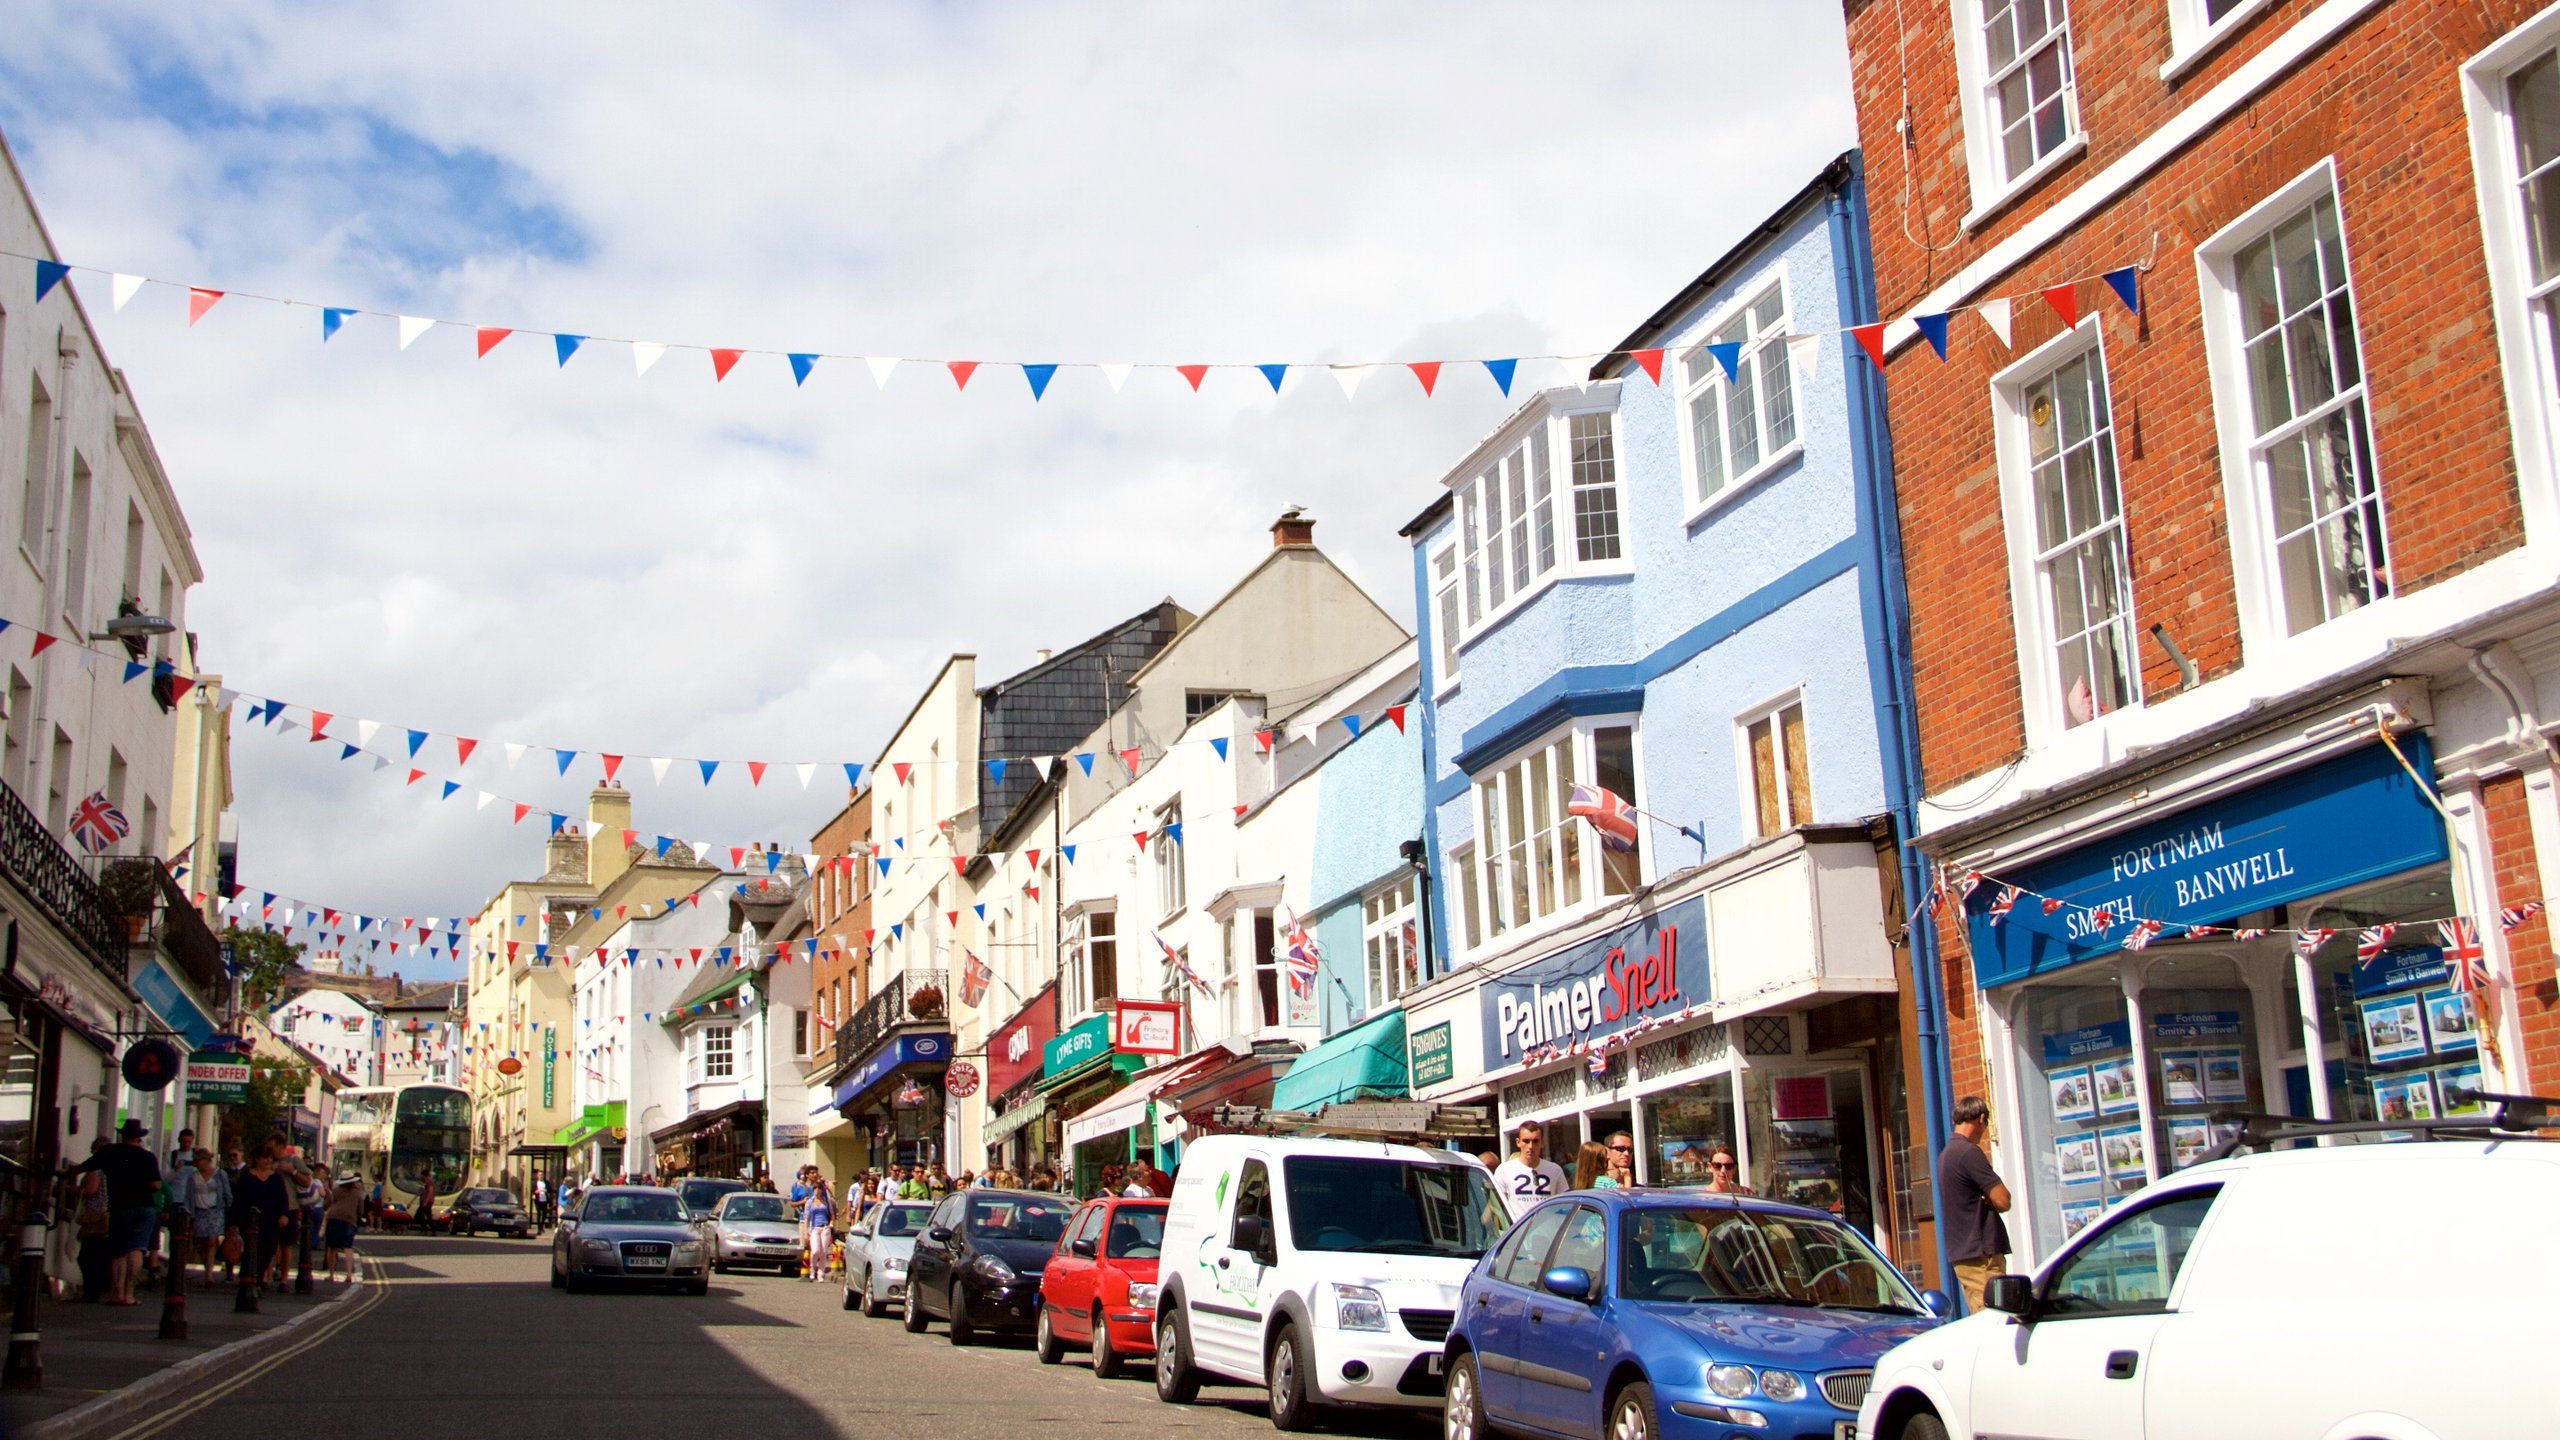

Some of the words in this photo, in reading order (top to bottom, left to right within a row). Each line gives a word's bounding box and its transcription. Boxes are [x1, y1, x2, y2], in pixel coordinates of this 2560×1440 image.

[2112, 821, 2225, 883] FORTNAM
[2066, 895, 2135, 940] SMTH
[2175, 848, 2294, 908] BANWELL
[2396, 952, 2428, 966] Fortnam
[2385, 972, 2407, 985] Smith
[2408, 970, 2415, 981] &
[2175, 1014, 2217, 1022] Fortnam
[1144, 1025, 1169, 1035] Primary
[2079, 1029, 2102, 1040] Fortnam
[2158, 1026, 2186, 1036] Smith
[2200, 1025, 2238, 1034] Banwell
[546, 1027, 554, 1059] POST
[1143, 1034, 1169, 1042] Colours
[1056, 1037, 1073, 1065] LYME
[1073, 1032, 1092, 1052] GIFTS
[2070, 1044, 2086, 1056] Smith
[2091, 1036, 2113, 1051] Banwell
[218, 1067, 247, 1080] OFFER
[950, 1065, 974, 1075] COSTA
[545, 1061, 553, 1106] OFFICE
[950, 1083, 977, 1095] COFFEE
[1514, 1174, 1551, 1195] 22
